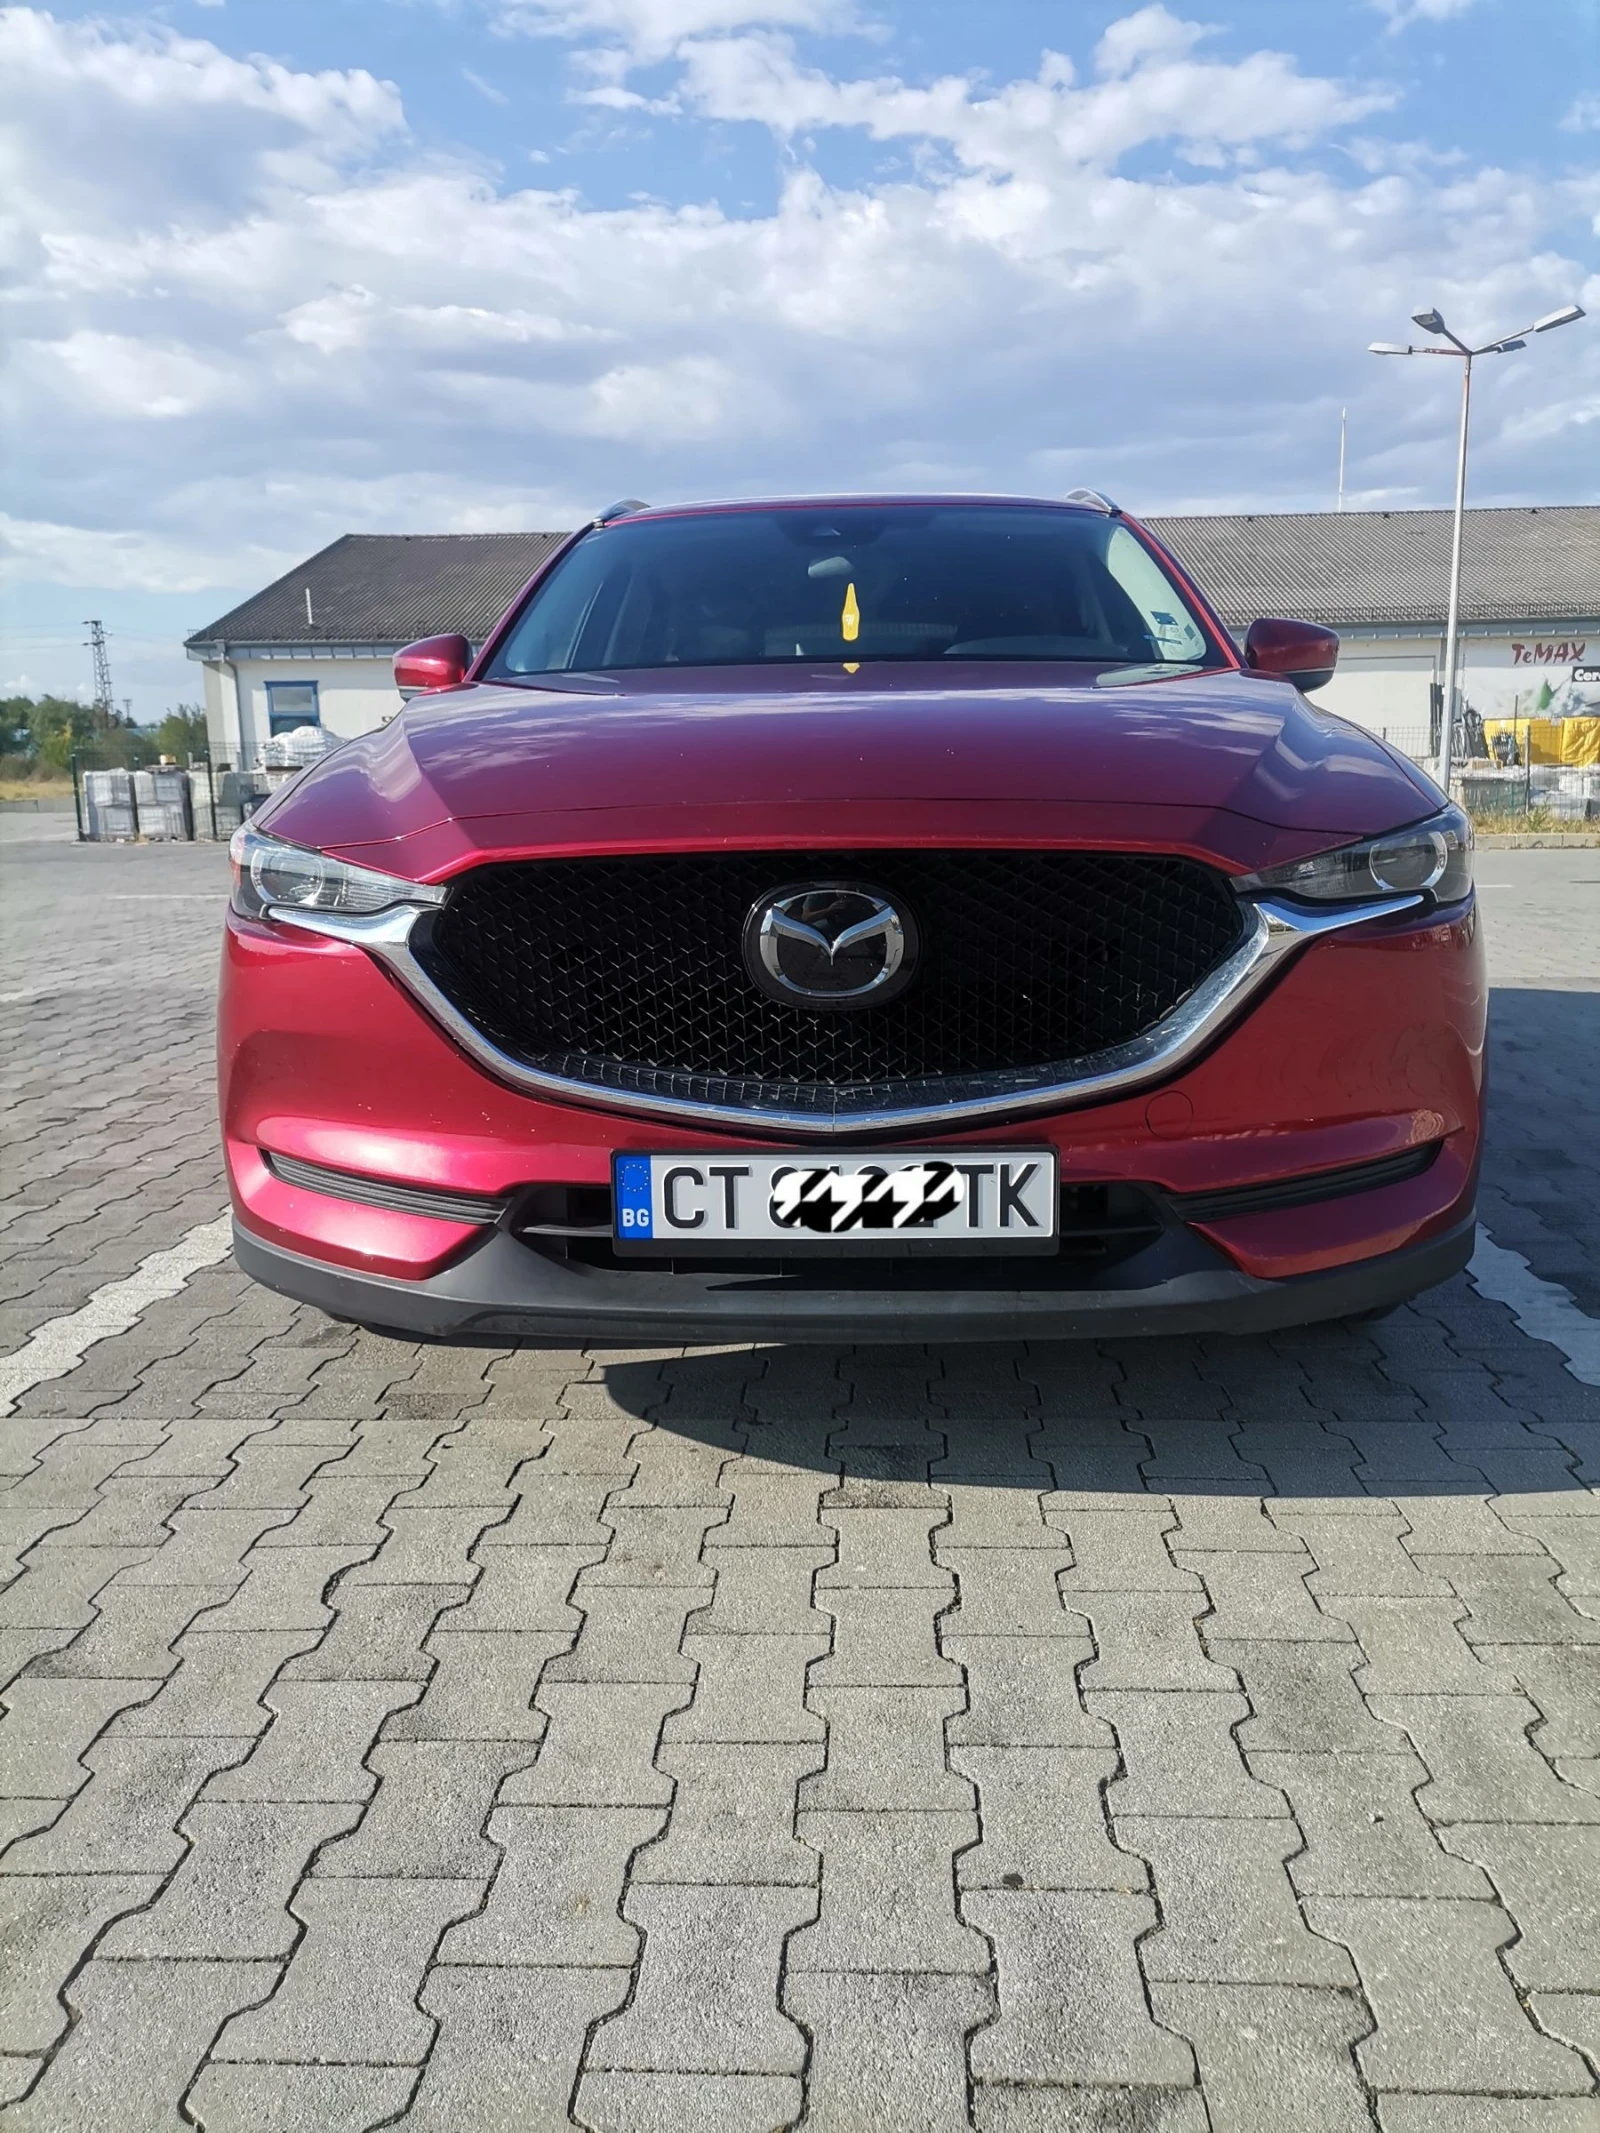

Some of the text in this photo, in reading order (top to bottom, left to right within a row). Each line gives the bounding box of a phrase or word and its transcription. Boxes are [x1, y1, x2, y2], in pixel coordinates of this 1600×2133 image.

[1511, 641, 1586, 665] TeMAX
[663, 1165, 750, 1229] CT
[622, 1208, 649, 1227] BG
